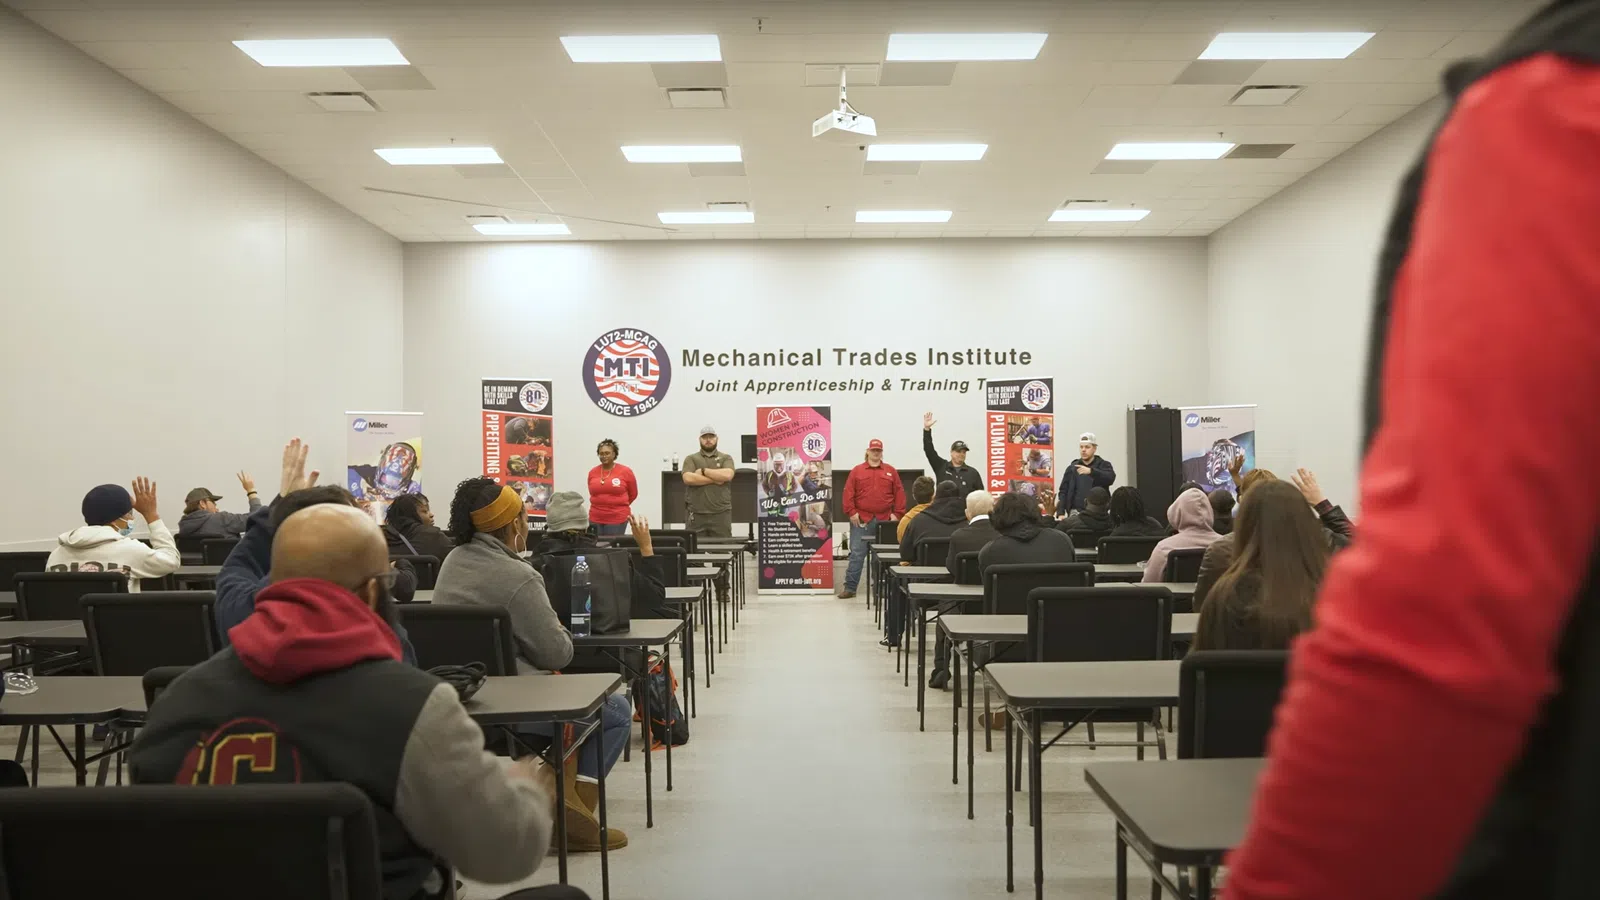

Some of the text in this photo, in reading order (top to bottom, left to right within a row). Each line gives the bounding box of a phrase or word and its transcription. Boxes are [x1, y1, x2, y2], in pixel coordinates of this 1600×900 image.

[594, 330, 658, 352] LU72-MCAG
[682, 348, 1032, 367] Mechanical Trades Institute
[604, 357, 649, 377] MTI
[695, 379, 738, 392] Joint
[744, 378, 875, 395] Apprenticeship
[881, 379, 892, 391] &
[900, 378, 970, 394] Training
[1028, 388, 1043, 402] 80
[526, 389, 542, 403] 80
[598, 397, 658, 415] SINCE 1942
[760, 425, 790, 439] WOMEN
[762, 422, 819, 446] CONSTRUCTION
[486, 414, 500, 474] PIPEFITTING
[808, 439, 821, 451] 80
[991, 414, 1005, 476] PLUMBING
[991, 479, 1005, 488] &
[761, 490, 828, 509] We Can Do It!
